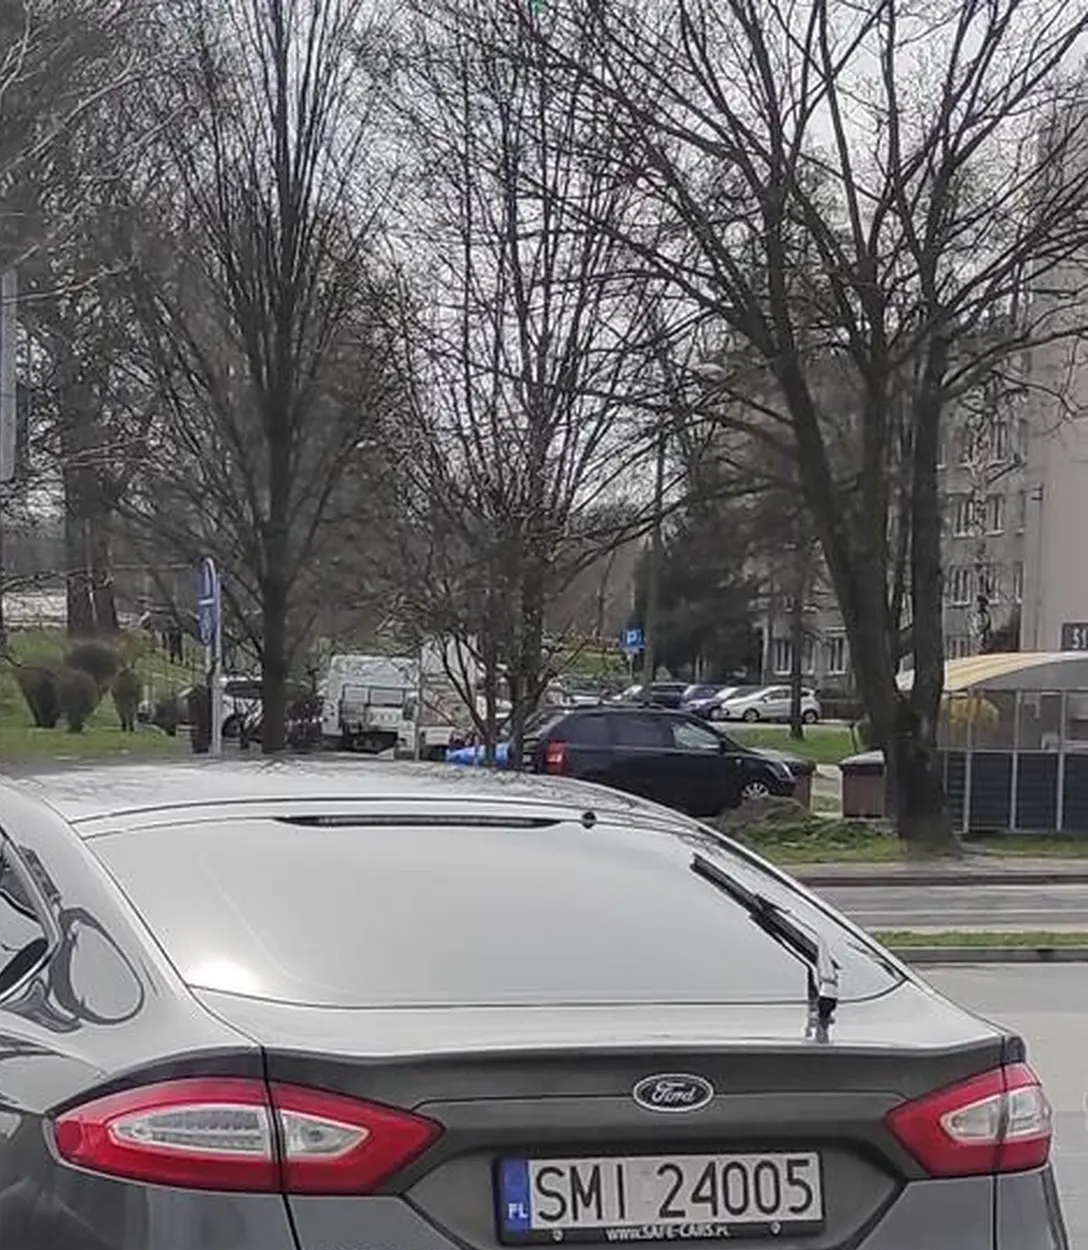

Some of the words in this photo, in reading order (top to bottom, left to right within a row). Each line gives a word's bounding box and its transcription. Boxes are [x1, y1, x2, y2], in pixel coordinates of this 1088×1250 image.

[651, 1080, 697, 1102] Ford
[535, 1162, 625, 1222] SMI
[656, 1159, 814, 1218] 24005
[508, 1203, 528, 1218] PL
